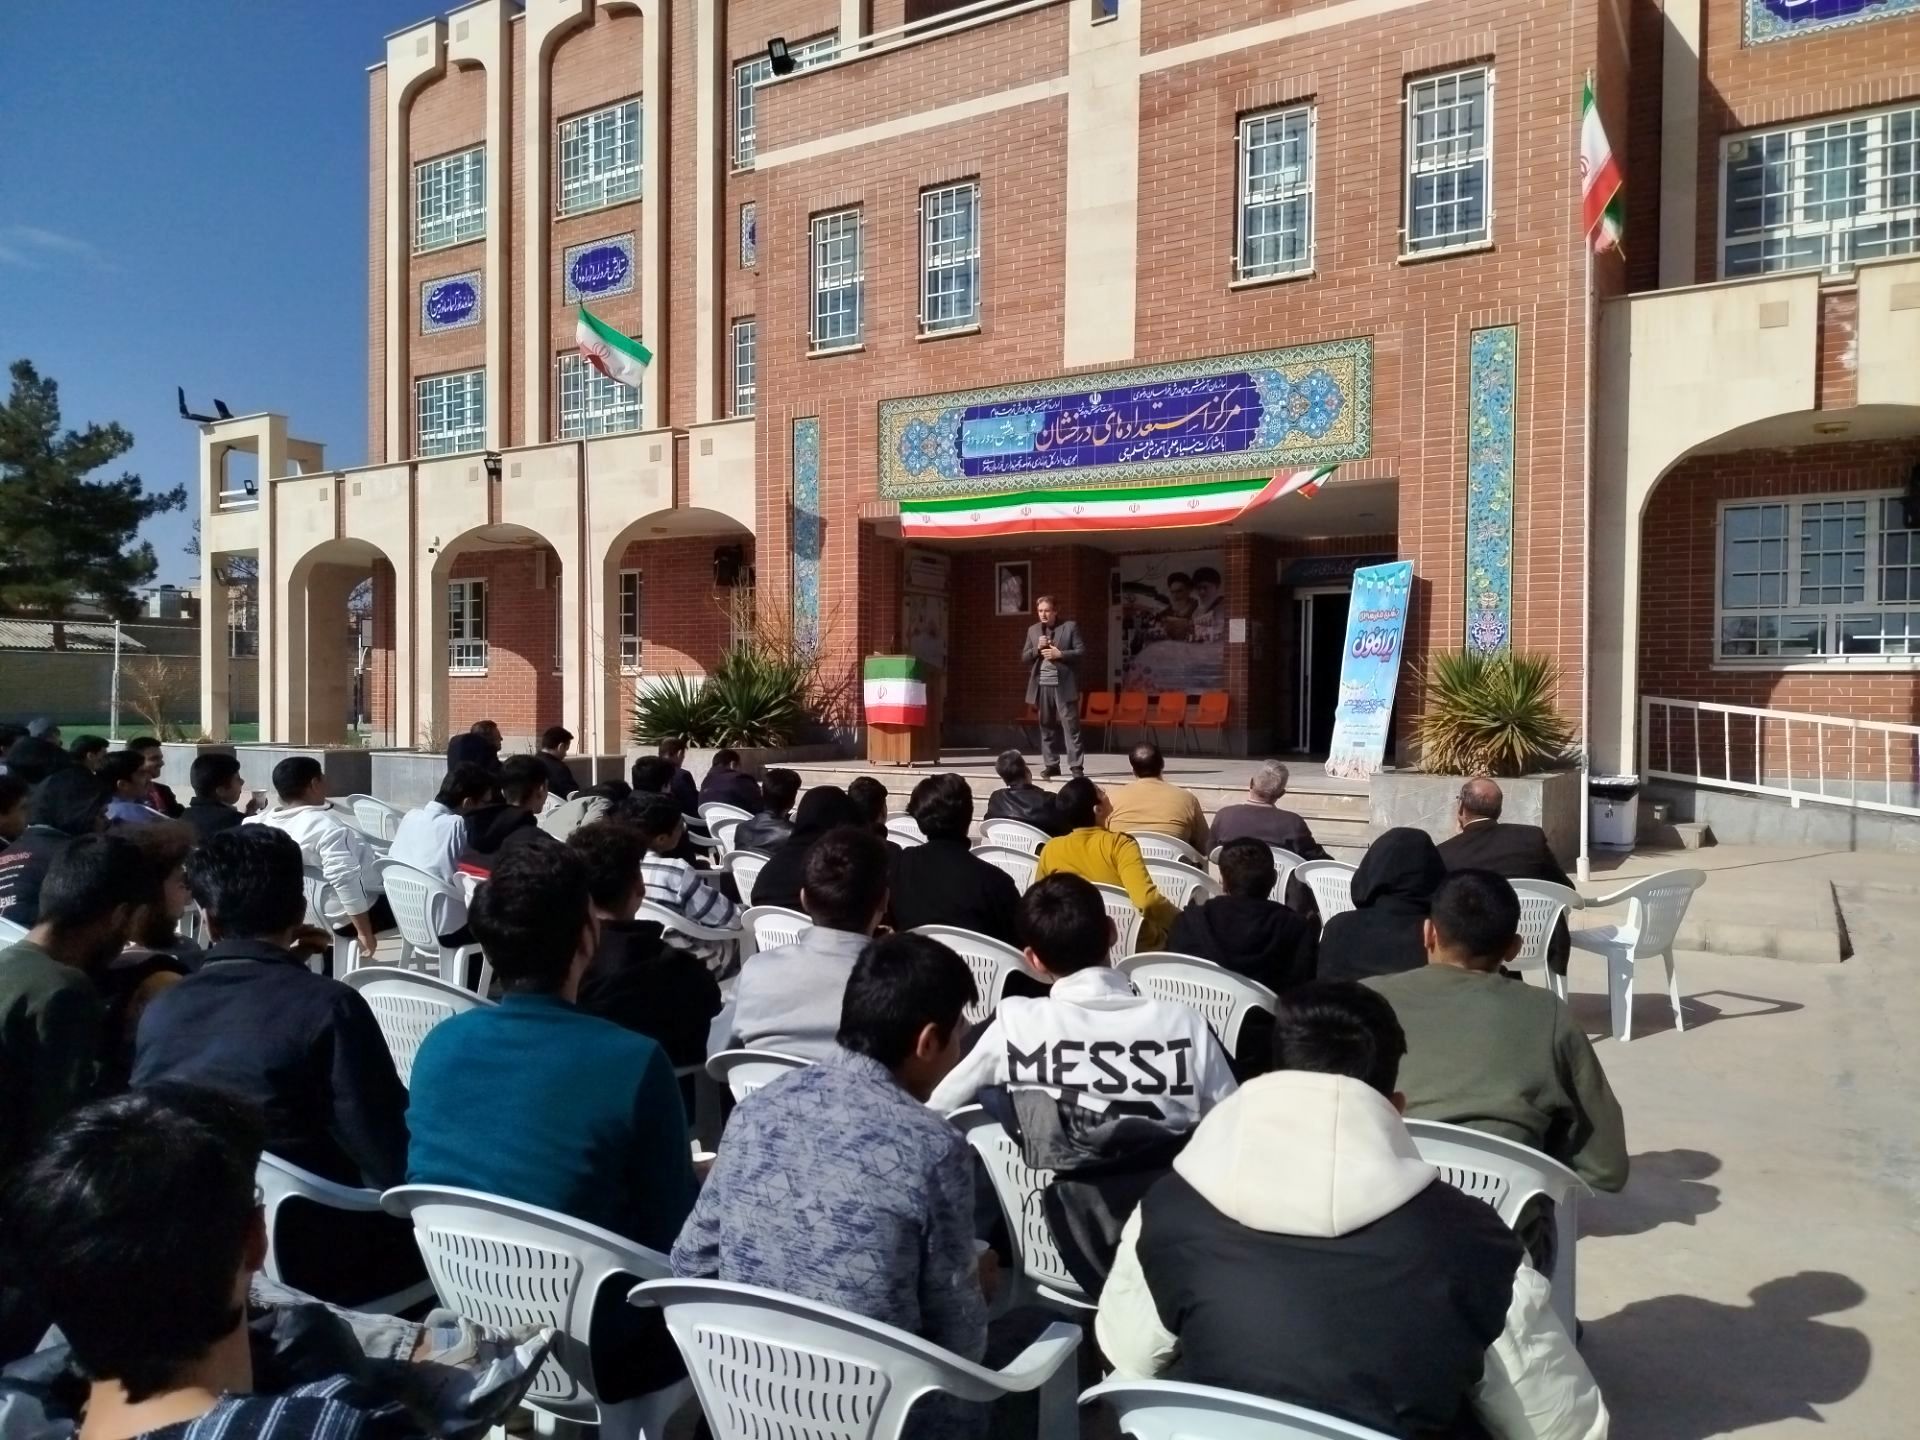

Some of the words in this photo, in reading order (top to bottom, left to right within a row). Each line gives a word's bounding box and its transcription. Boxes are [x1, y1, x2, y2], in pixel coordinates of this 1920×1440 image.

[1146, 384, 1171, 398] خراسان
[1187, 378, 1211, 394] آموزش
[1208, 378, 1226, 391] سازمان
[1132, 387, 1147, 401] رضوی
[1207, 384, 1241, 437] مرکز
[1035, 411, 1092, 452] درخشان
[1092, 401, 1212, 446] استعدادهای
[1142, 440, 1168, 460] آموزشی
[1163, 439, 1179, 458] علمی
[1175, 438, 1200, 456] بنیاد
[1194, 435, 1220, 452] مشارکت
[1006, 1038, 1194, 1096] MESSI
